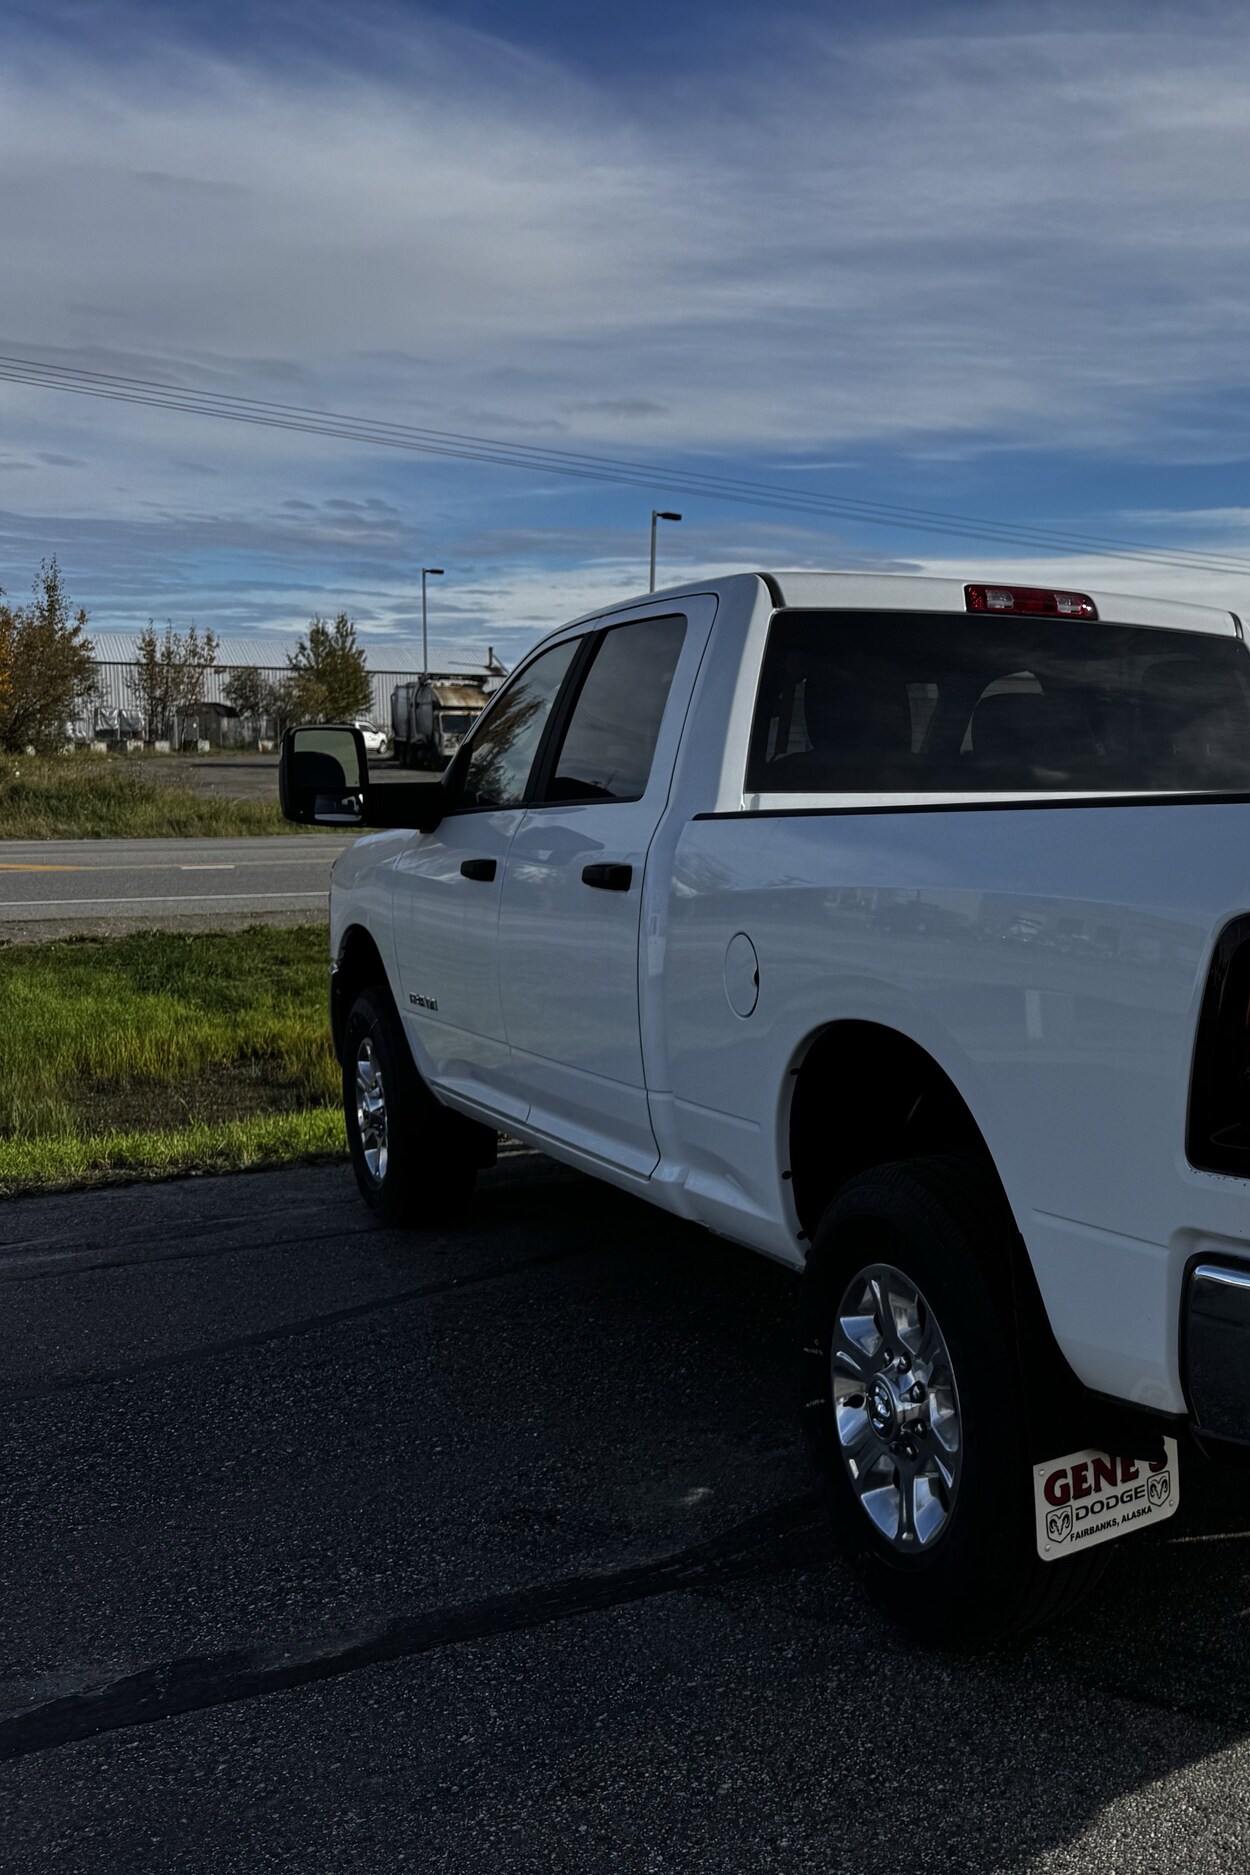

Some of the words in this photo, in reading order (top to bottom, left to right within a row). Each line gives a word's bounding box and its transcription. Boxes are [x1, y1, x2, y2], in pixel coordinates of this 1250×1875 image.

[1044, 1455, 1168, 1506] GENE
[1075, 1484, 1146, 1522] DODGE
[1070, 1517, 1120, 1542] FAIRBANKS,
[1121, 1505, 1153, 1524] ALASKA
